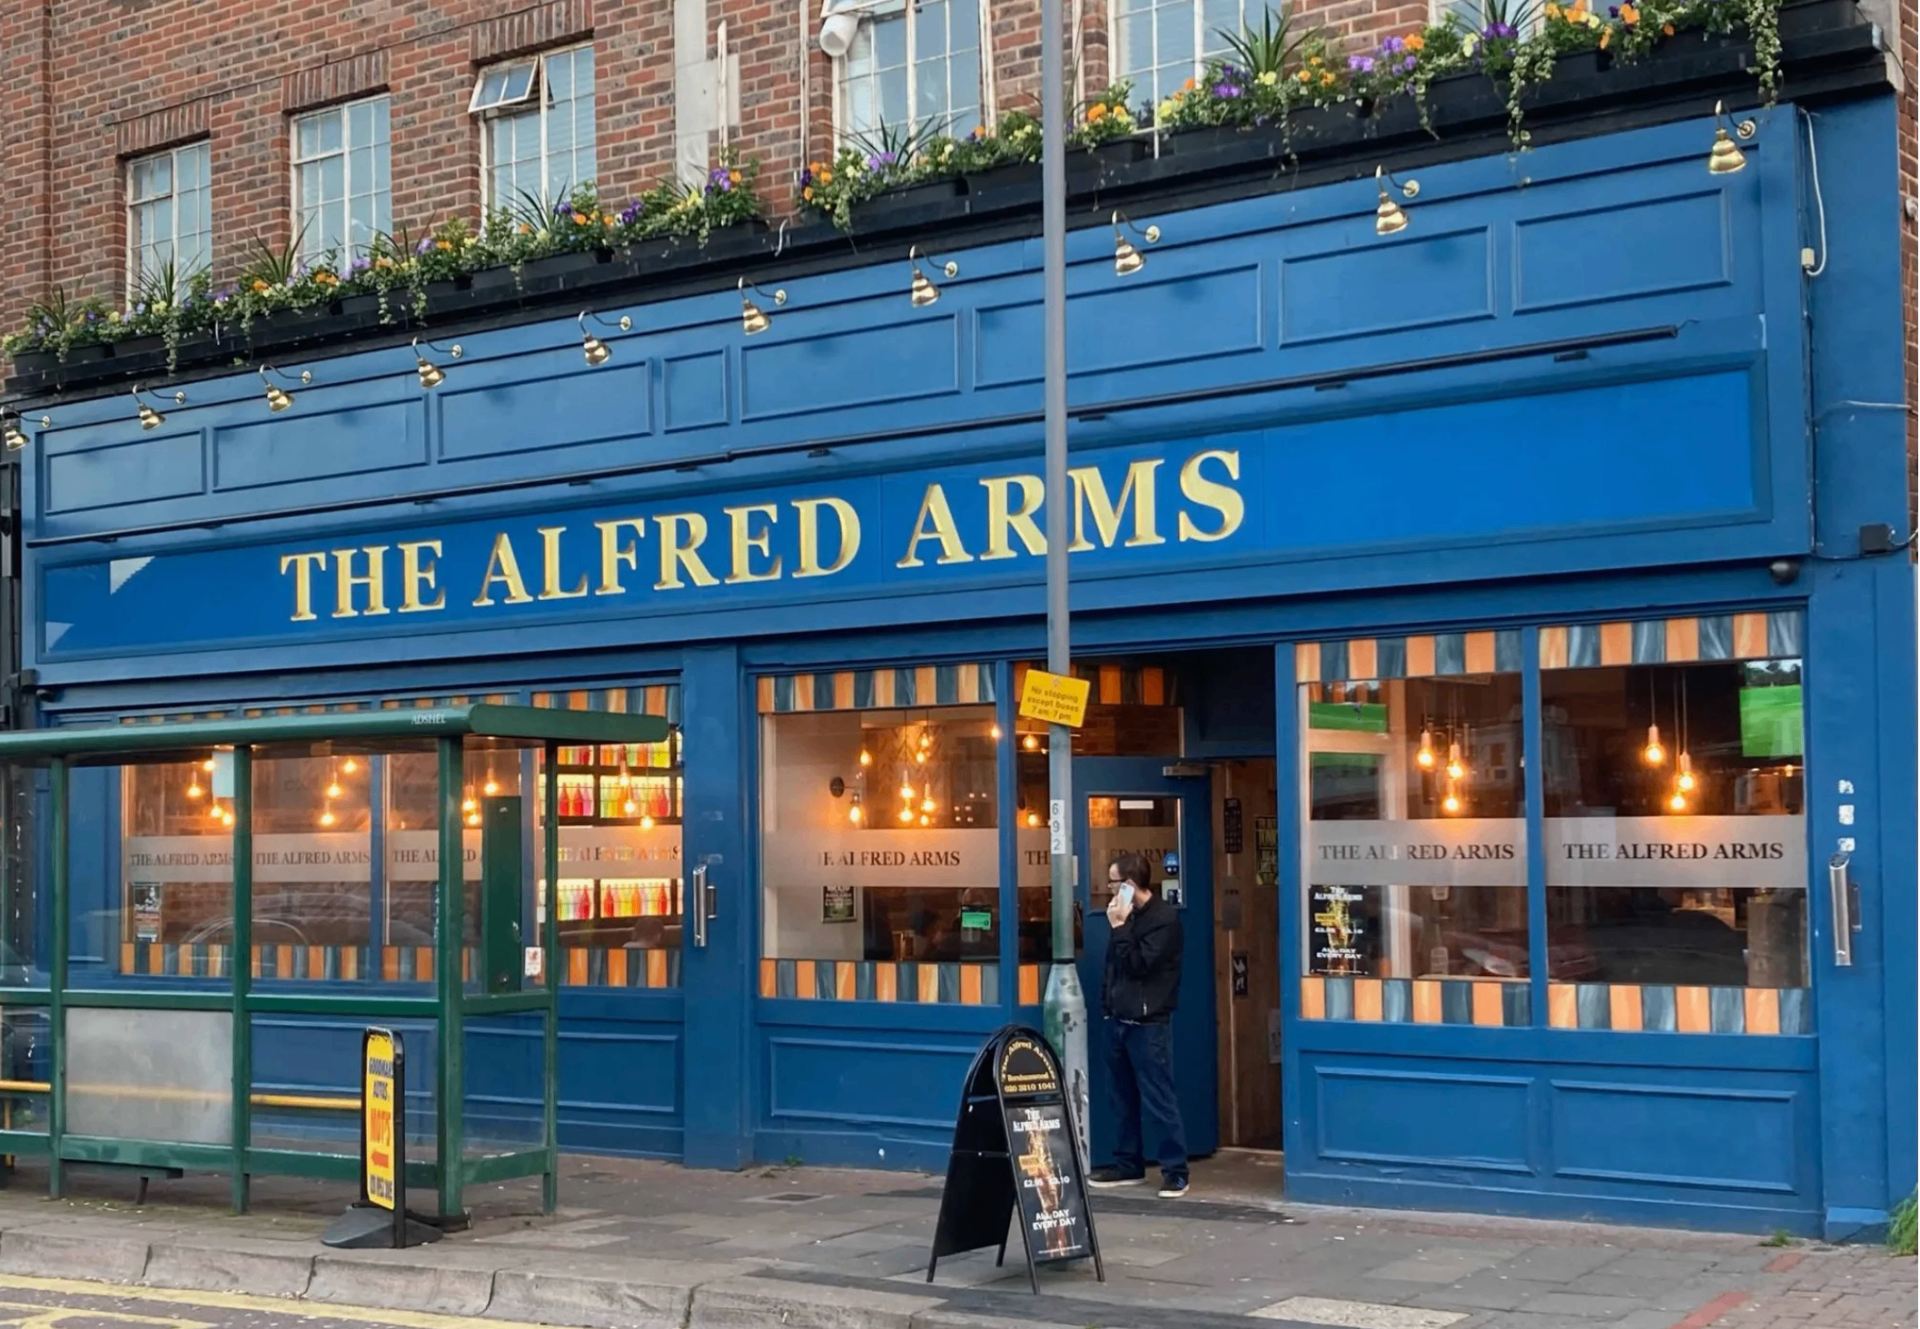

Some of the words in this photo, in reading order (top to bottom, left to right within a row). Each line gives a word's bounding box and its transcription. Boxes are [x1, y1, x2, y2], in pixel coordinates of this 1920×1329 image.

[280, 540, 446, 621] THE
[472, 497, 862, 607] ALFRED
[896, 449, 1245, 569] ARMS
[1031, 686, 1042, 694] No
[1044, 689, 1079, 703] stopping
[1027, 697, 1054, 708] except
[1055, 701, 1080, 712] buses
[411, 713, 447, 725] ADSHEL
[255, 852, 280, 865] THE
[281, 851, 331, 865] ALFRED
[335, 851, 370, 865] ARMS
[393, 850, 421, 864] THE
[909, 850, 961, 867] ARMS
[1024, 850, 1051, 866] TH
[1318, 845, 1361, 860] THE
[1452, 844, 1515, 860] ARMS
[1562, 843, 1610, 859] THE
[1615, 843, 1708, 859] ALFRED
[1713, 843, 1784, 859] ARMS
[129, 853, 152, 866] THE
[154, 852, 199, 867] ALFRED
[1008, 1041, 1032, 1057] Alfred
[1038, 1082, 1056, 1091] 1041
[1052, 1209, 1070, 1218] DAY
[1032, 1220, 1058, 1231] EVERY
[1059, 1217, 1077, 1227] DAY
